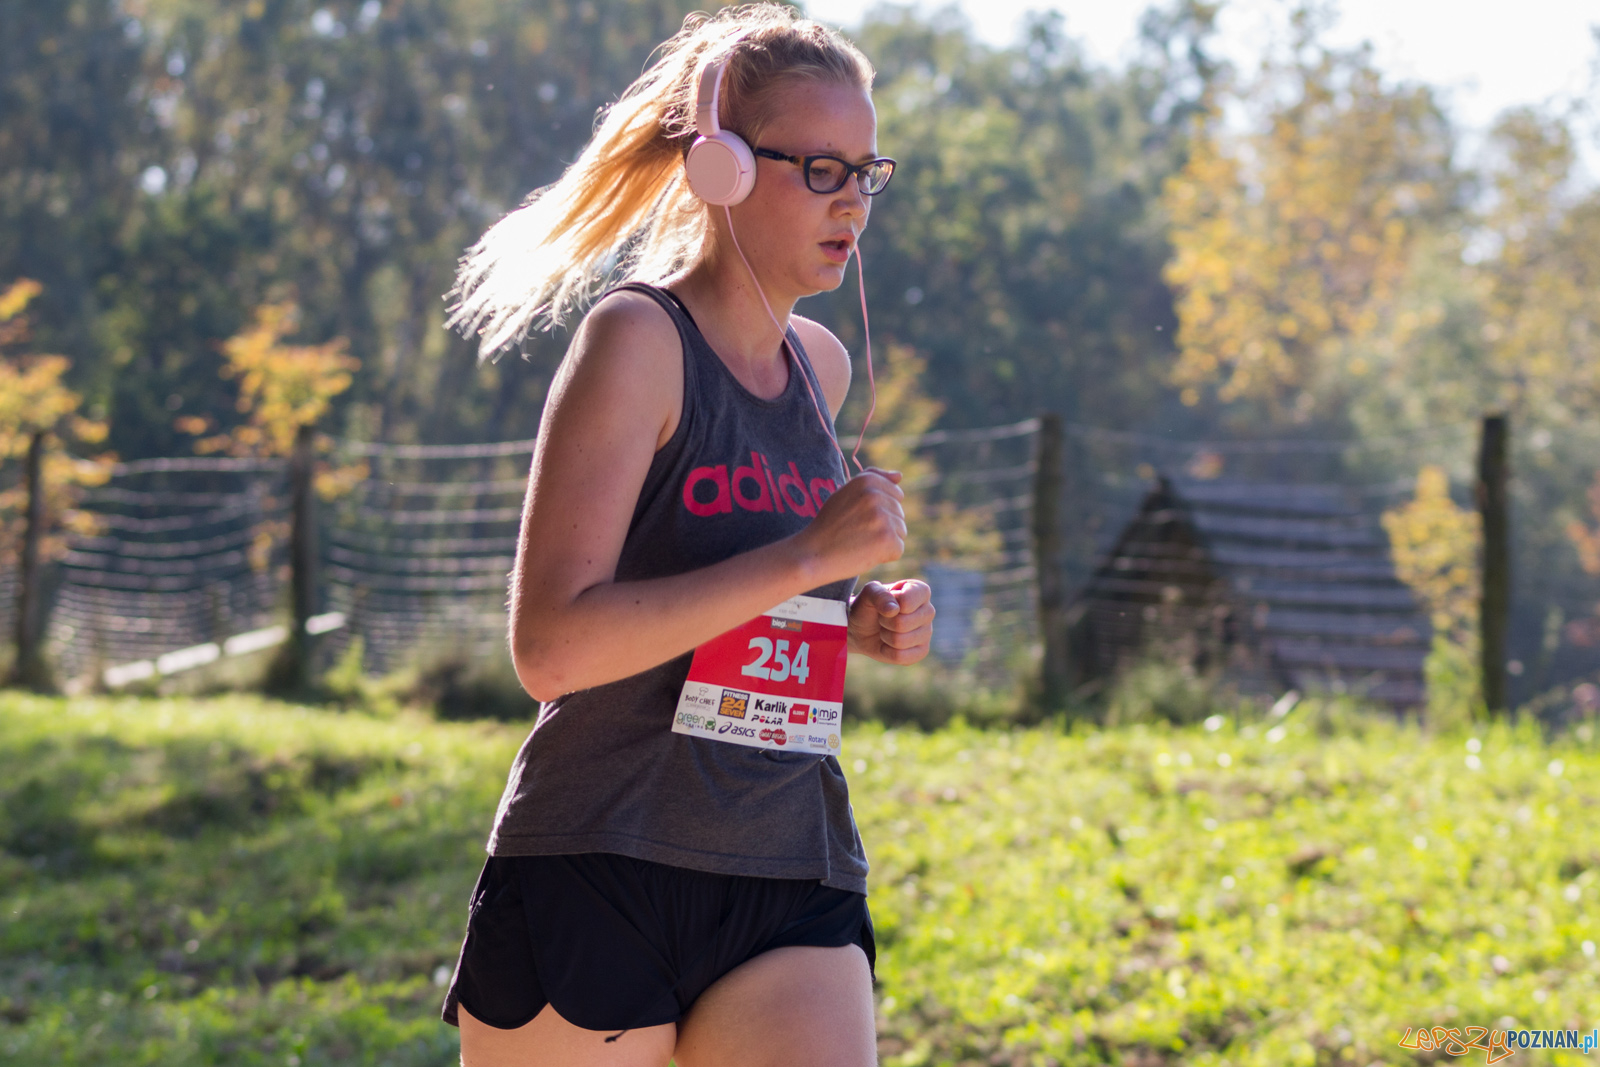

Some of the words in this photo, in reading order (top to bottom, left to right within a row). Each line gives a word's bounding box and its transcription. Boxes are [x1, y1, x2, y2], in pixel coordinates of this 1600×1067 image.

[683, 451, 842, 517] adida
[741, 636, 810, 685] 254
[723, 691, 748, 700] FITNESS
[721, 696, 746, 711] 24
[754, 699, 788, 714] Karlik
[676, 712, 705, 725] green
[720, 707, 745, 718] SEVEN
[819, 708, 838, 721] mjp
[751, 714, 783, 726] POLAR
[808, 735, 827, 745] Rotary
